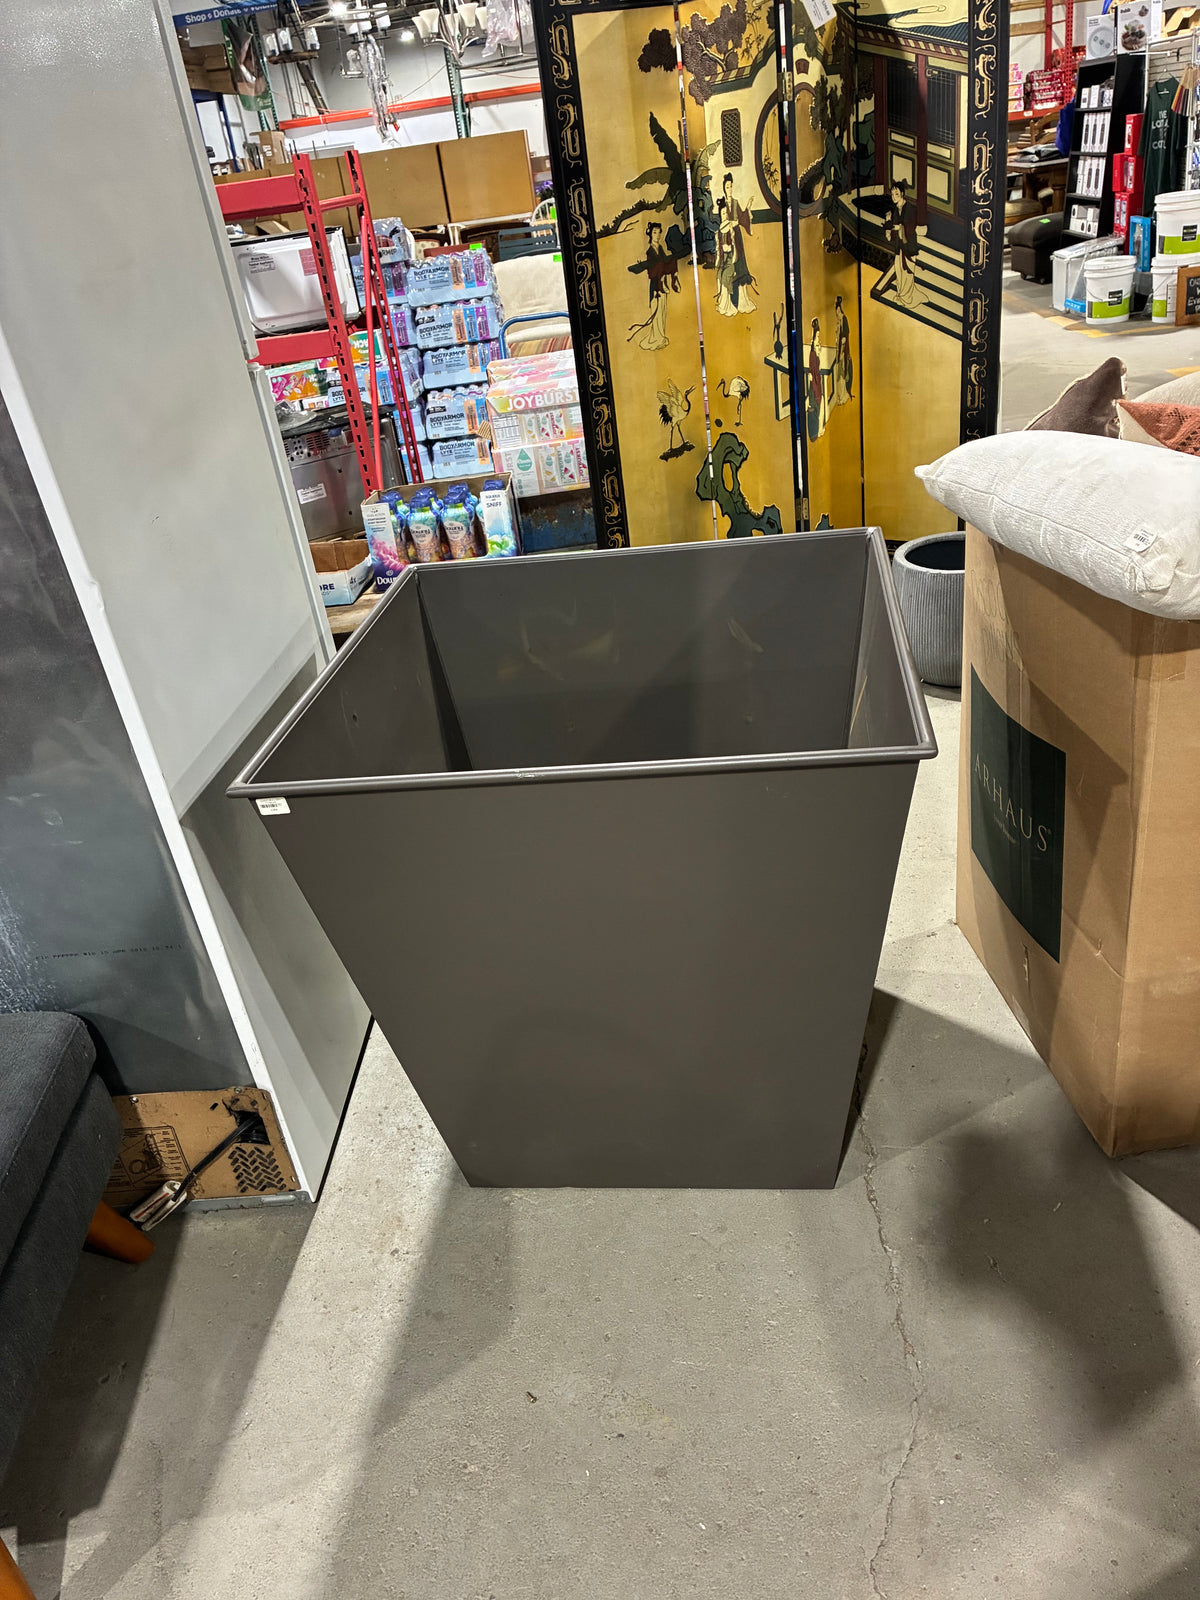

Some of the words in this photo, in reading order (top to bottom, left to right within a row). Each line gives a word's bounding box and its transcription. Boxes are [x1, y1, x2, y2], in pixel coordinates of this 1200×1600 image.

[185, 14, 207, 23] Shop
[419, 322, 453, 334] BODYARMOR
[507, 389, 579, 411] JOYBURST
[429, 412, 465, 423] BODYARMOR
[439, 441, 476, 451] BODYARMOR
[975, 753, 1047, 852] ARHAUS
